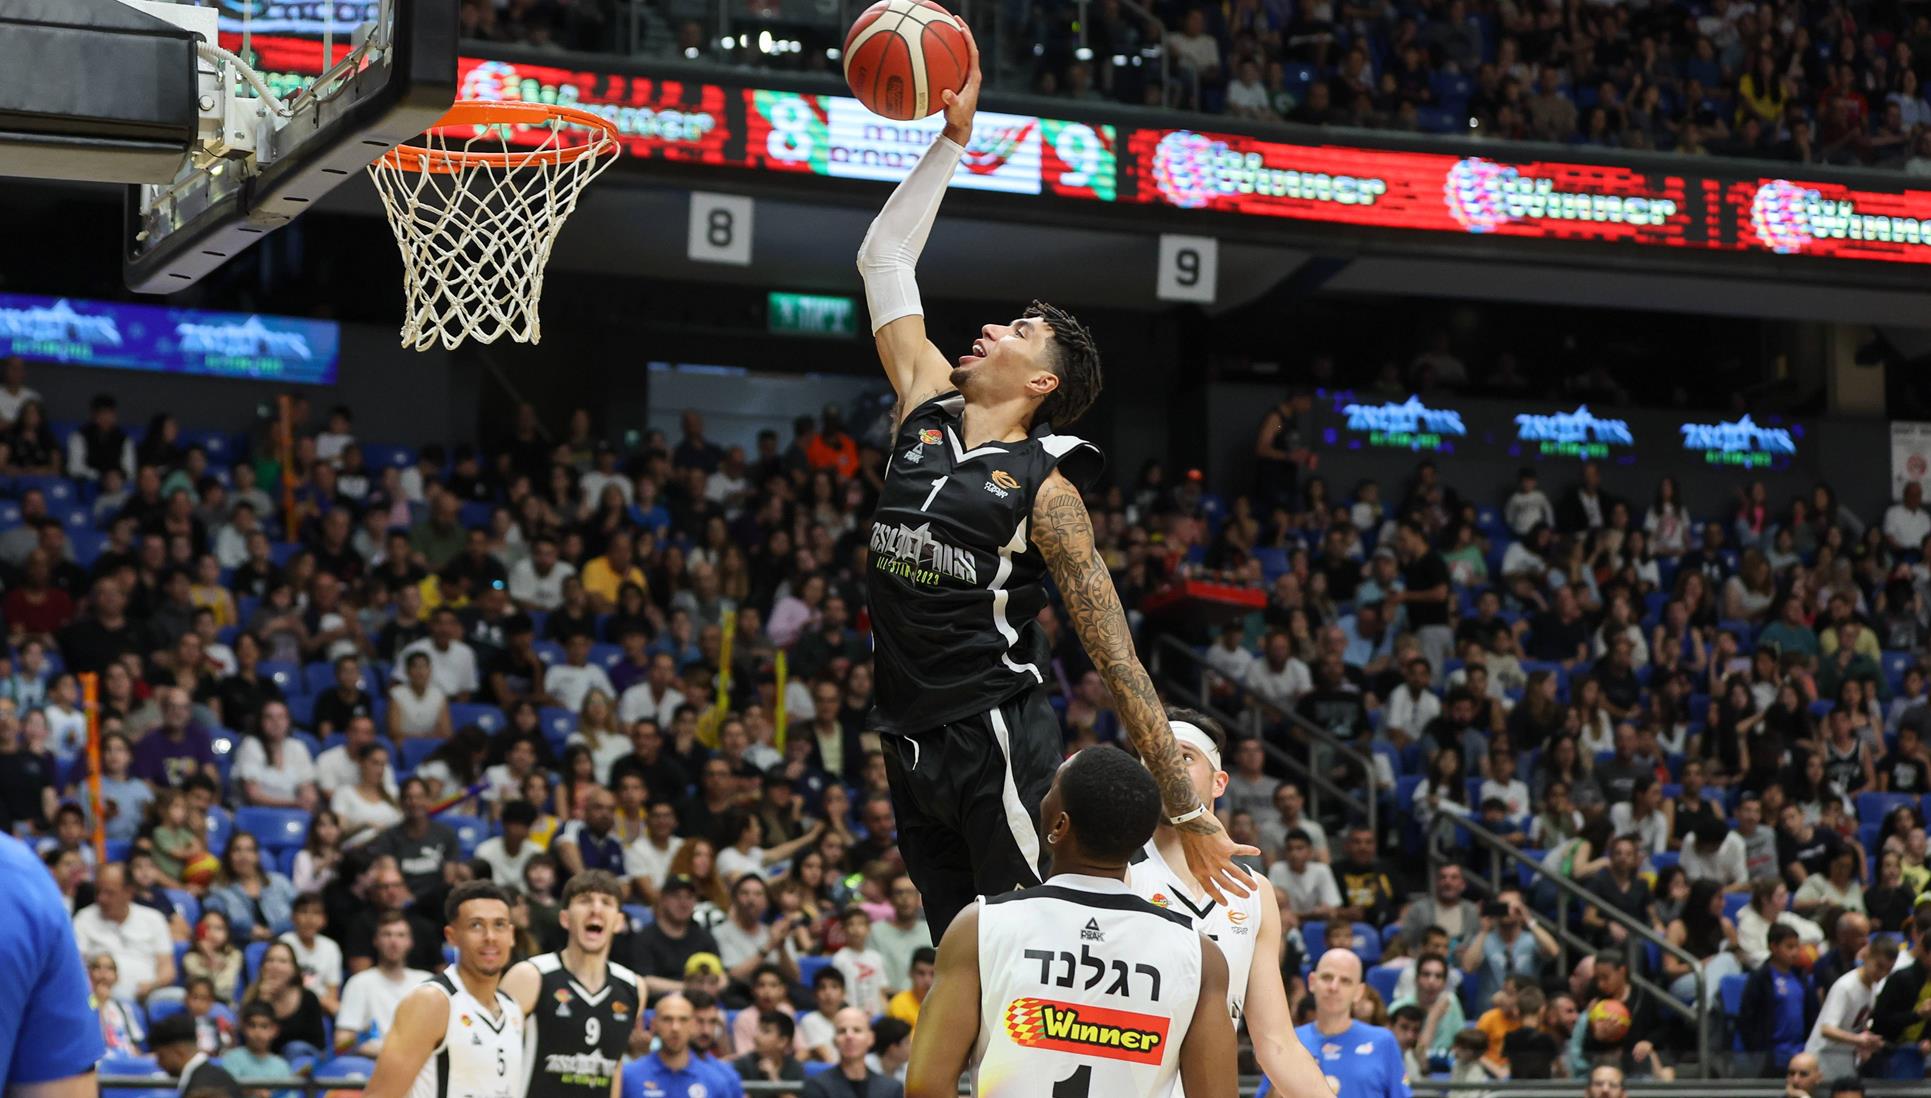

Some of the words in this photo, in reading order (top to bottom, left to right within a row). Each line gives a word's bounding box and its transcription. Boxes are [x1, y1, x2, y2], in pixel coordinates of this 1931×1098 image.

[1055, 123, 1098, 186] 9
[1212, 141, 1387, 206] Winner
[1502, 167, 1677, 225] Winner
[708, 208, 733, 247] 8
[1176, 248, 1200, 287] 9
[920, 475, 949, 513] 1
[916, 569, 940, 586] 2023
[1080, 929, 1106, 942] PEAK
[1024, 944, 1161, 1002] רגלנד
[585, 1016, 601, 1046] 9
[1043, 1006, 1161, 1052] Winner
[497, 1047, 506, 1077] 5
